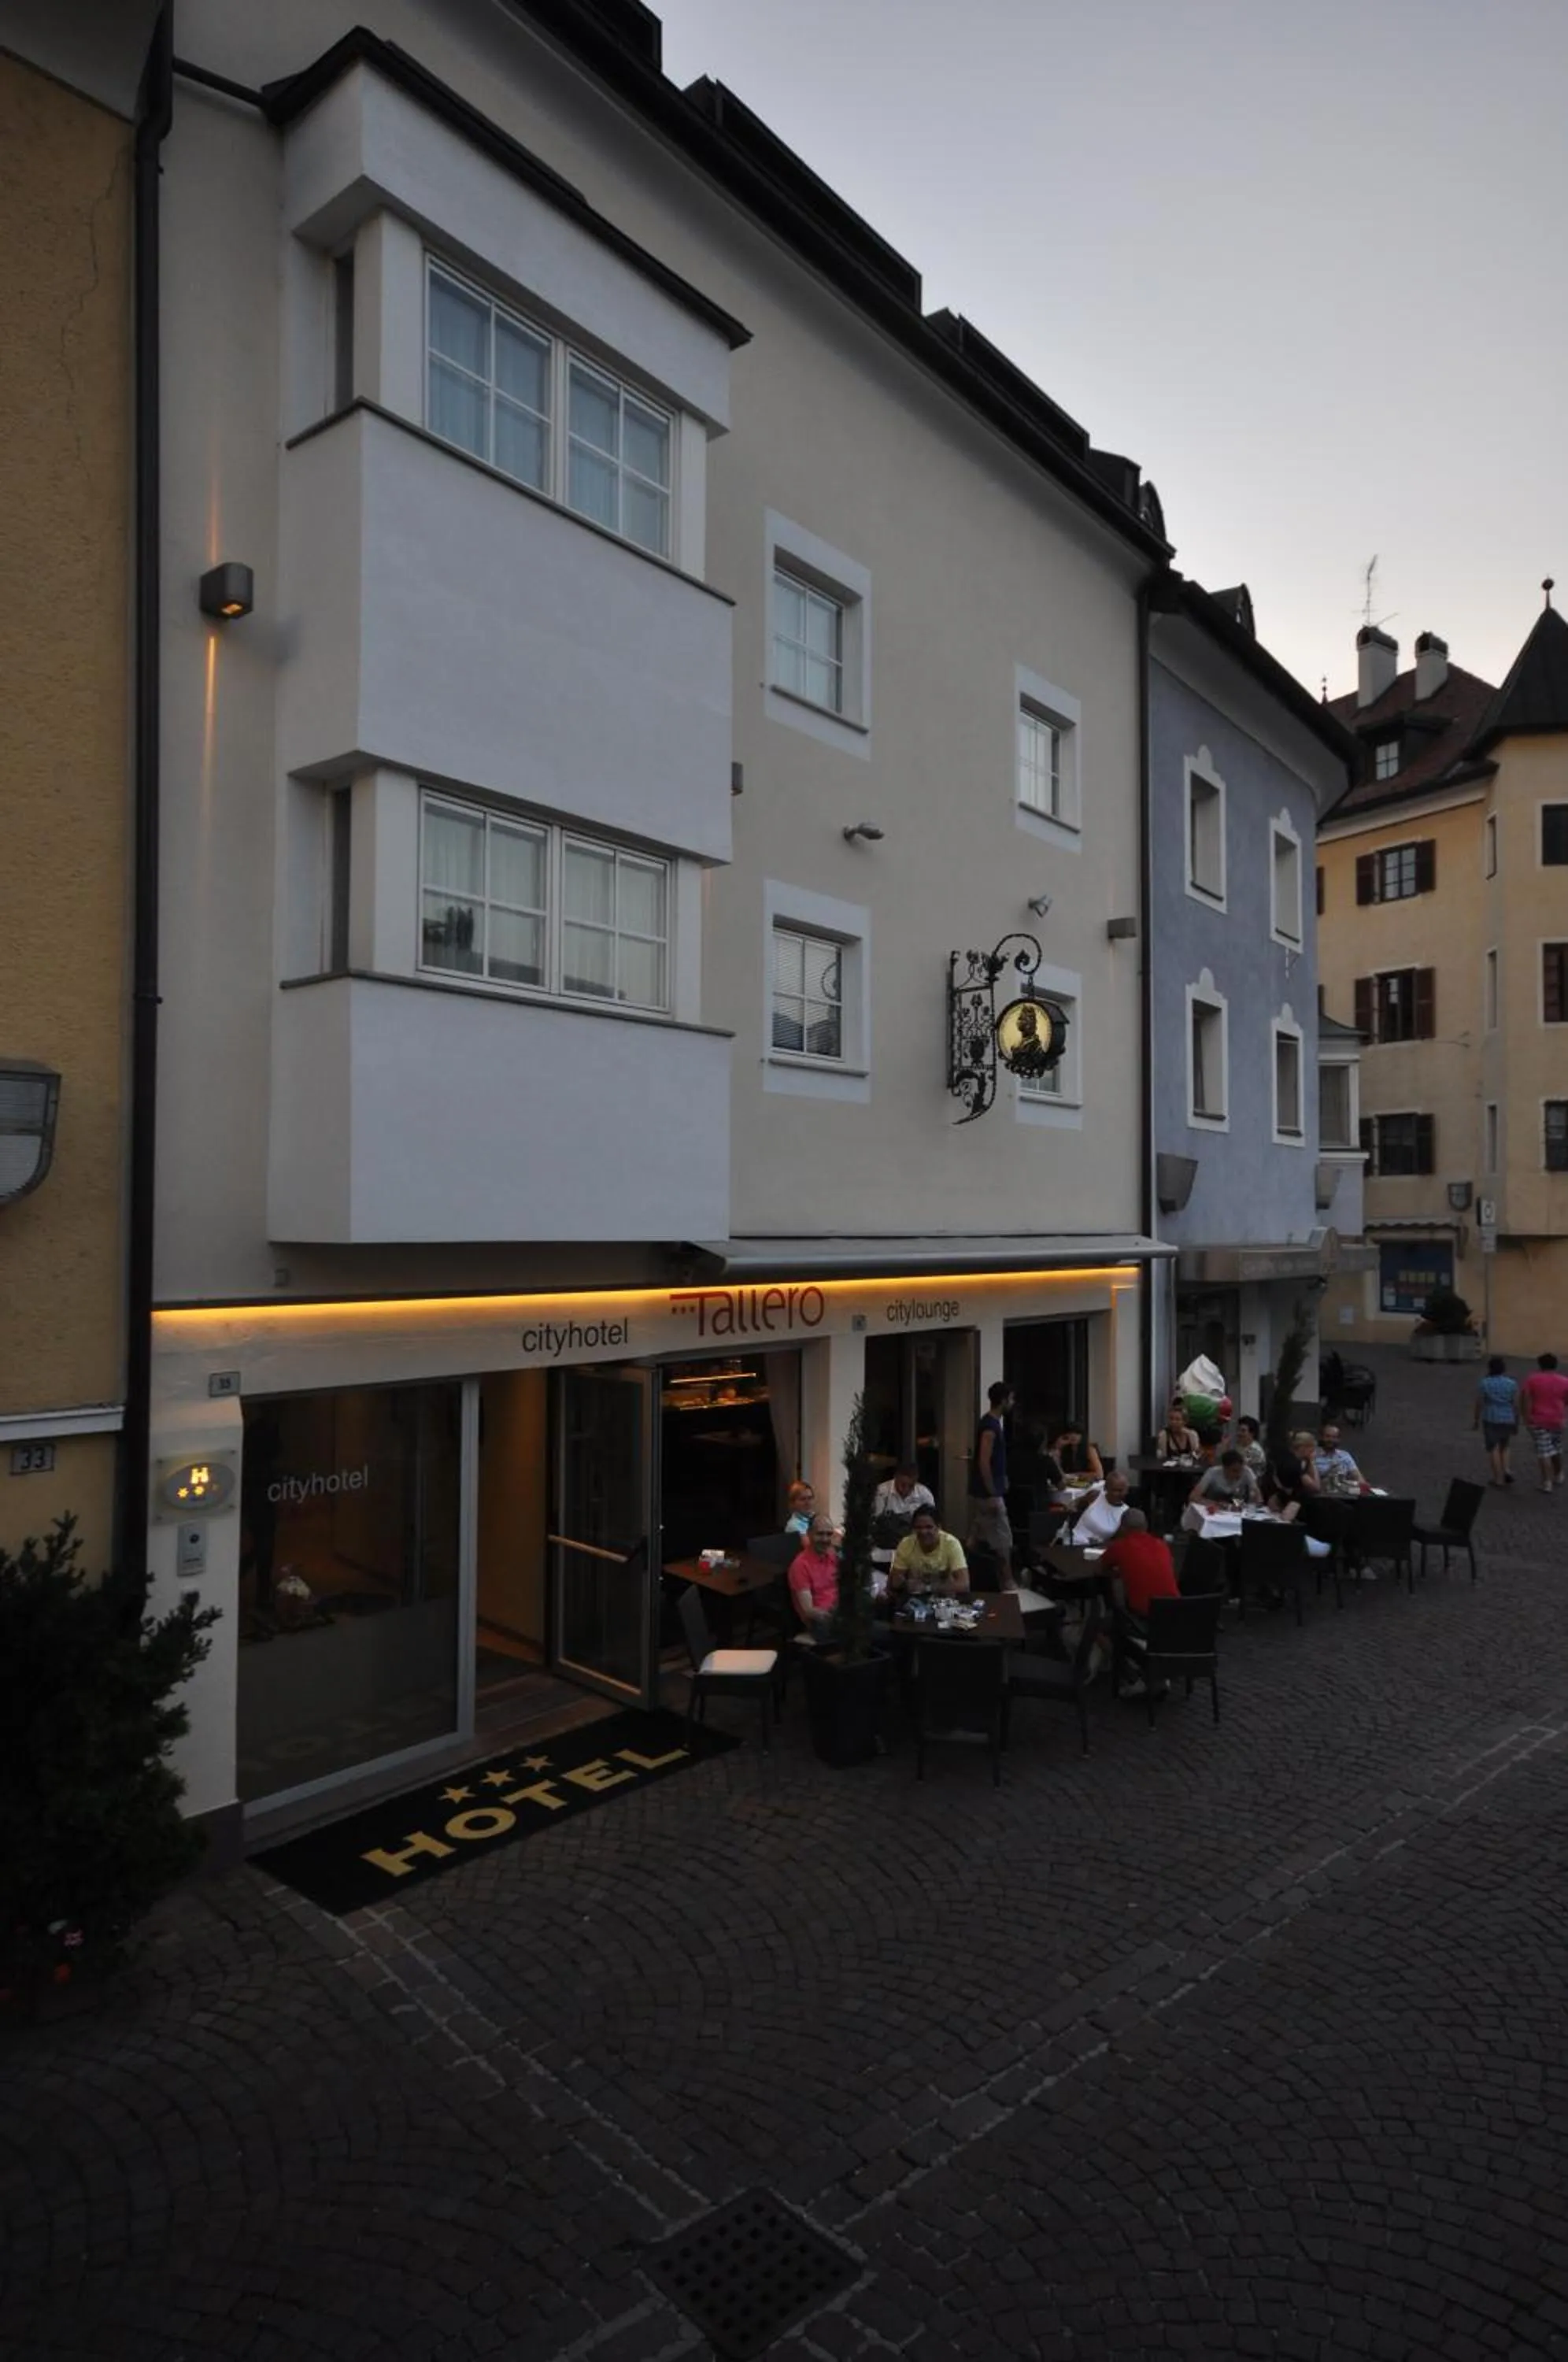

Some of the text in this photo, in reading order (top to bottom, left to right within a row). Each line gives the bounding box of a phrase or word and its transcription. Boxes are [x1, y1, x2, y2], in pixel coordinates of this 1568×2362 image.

[670, 1287, 825, 1336] Tallero
[522, 1316, 628, 1357] cityhotel
[20, 1447, 46, 1469] 33
[191, 1467, 209, 1484] H
[266, 1463, 368, 1505] cityhotel
[359, 1747, 691, 1878] HOTEL
